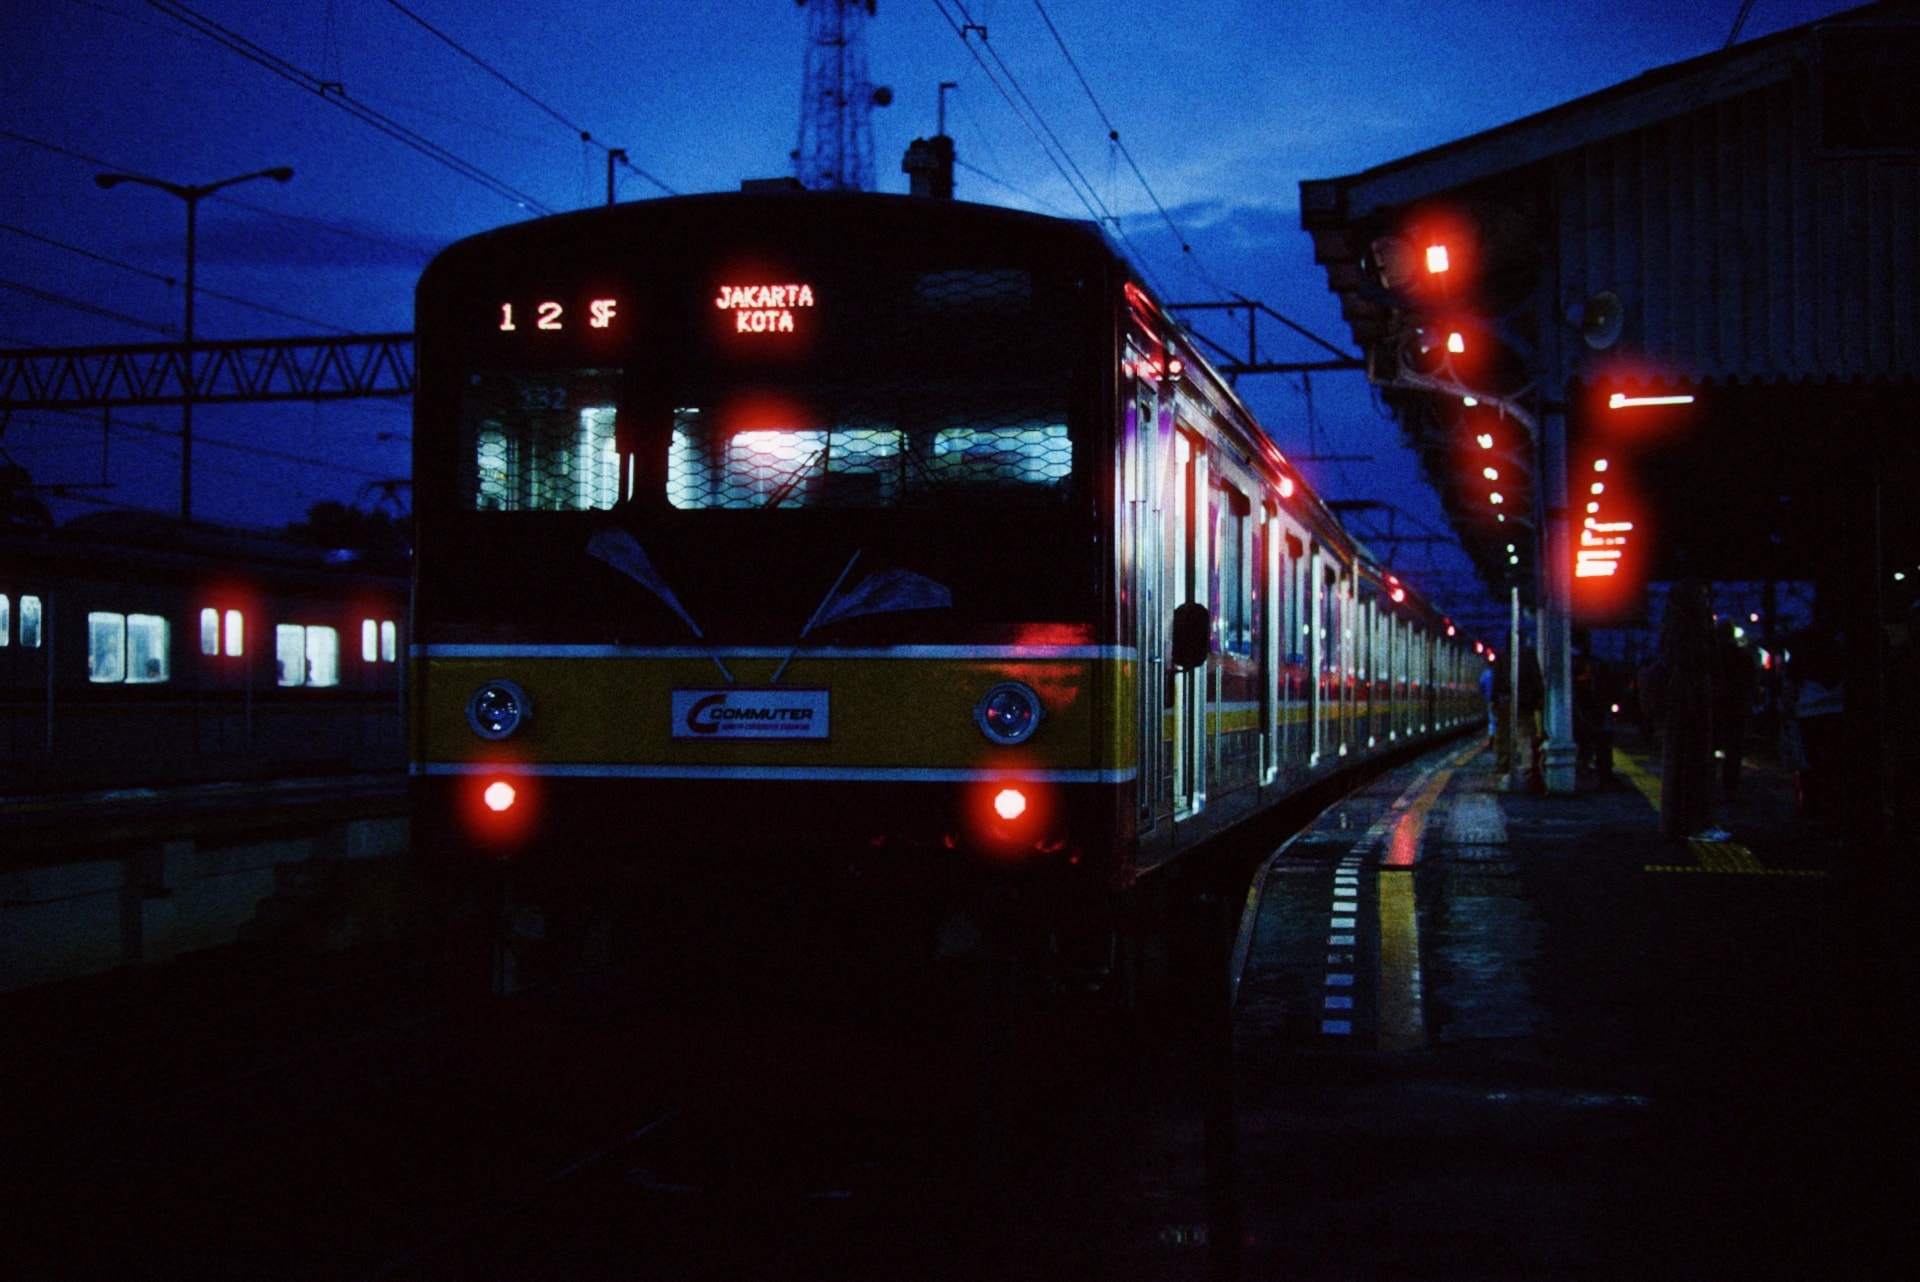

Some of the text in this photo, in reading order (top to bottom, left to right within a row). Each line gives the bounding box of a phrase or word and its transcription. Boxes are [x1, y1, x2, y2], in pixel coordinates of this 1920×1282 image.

[716, 285, 814, 309] JAKARTA
[590, 300, 617, 328] SF
[736, 310, 794, 333] KOTA
[710, 708, 814, 720] COMMUTER
